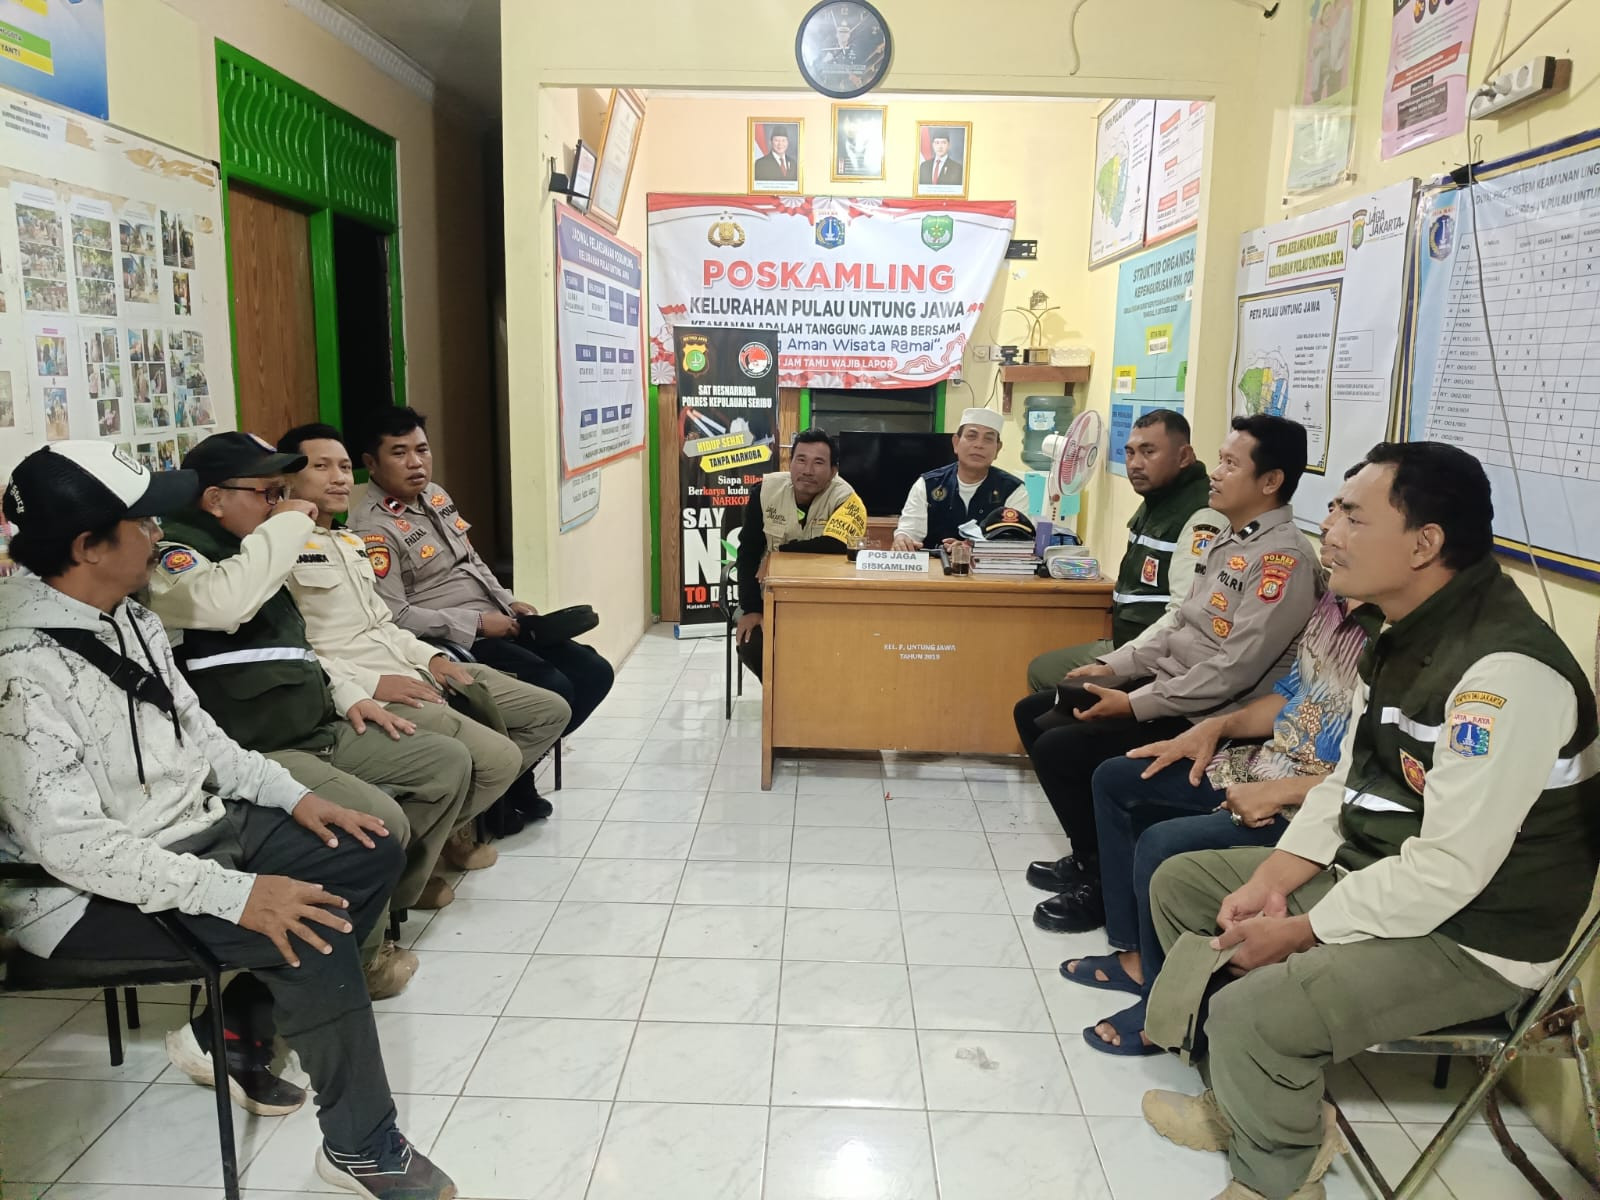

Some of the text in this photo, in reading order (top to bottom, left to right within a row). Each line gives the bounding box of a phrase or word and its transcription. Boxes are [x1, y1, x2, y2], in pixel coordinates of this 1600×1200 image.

[1536, 167, 1580, 190] KEAMANAN
[1366, 206, 1403, 237] JAGA JAKARTA
[1133, 247, 1196, 283] STRUKTUR ORGANISA
[703, 259, 955, 293] POSKAMLING
[690, 297, 965, 319] KELURAHAN PULAU UNTUNG JAWA
[1249, 300, 1321, 320] PETA PULAU UNTUNG JAWA
[805, 323, 867, 336] TANGGUNG
[869, 324, 909, 336] JAWAB
[910, 322, 962, 336] BERSAMA
[787, 337, 828, 351] Aman
[832, 338, 886, 352] Wisata
[783, 358, 895, 369] JAM TAMU WAJIB LAPOR
[698, 384, 757, 397] SAT RESNARKOBA
[682, 396, 773, 409] POLRES KEPULAUAN SERIBU
[696, 434, 745, 453] HIDUP SEHAT
[709, 448, 762, 468] TANPA NARKOBA
[717, 474, 742, 486] Siapa
[687, 485, 749, 498] Berkarya kudu
[682, 507, 726, 529] SAY
[404, 528, 428, 548] FAIZAL
[868, 551, 917, 560] POS JAGA
[1263, 554, 1295, 566] POLRES
[861, 562, 923, 572] SISKAMLING
[1216, 570, 1243, 592] POLRI
[684, 586, 707, 604] TO
